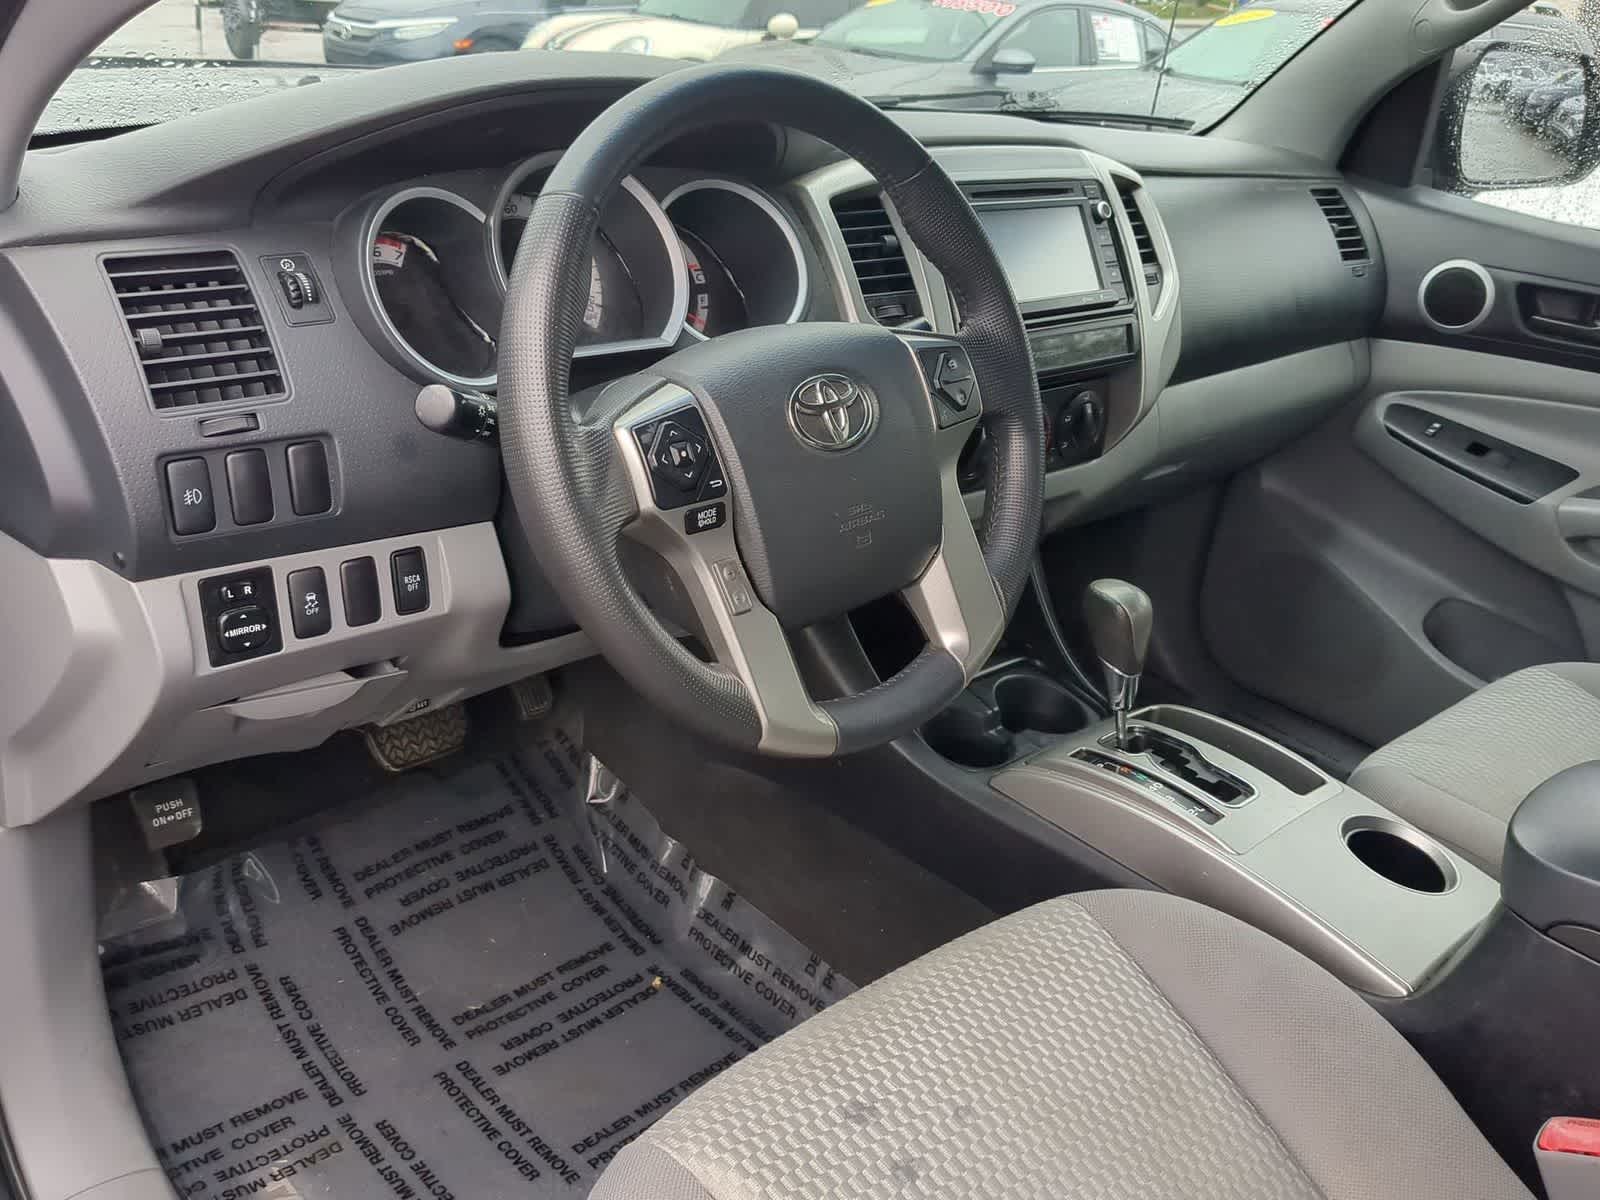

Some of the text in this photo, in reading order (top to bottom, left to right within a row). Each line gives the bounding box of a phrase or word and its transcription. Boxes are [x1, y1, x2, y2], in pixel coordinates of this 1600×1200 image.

[394, 249, 404, 261] 7
[697, 507, 717, 521] MODE
[227, 585, 253, 599] L R
[404, 574, 421, 584] RSCA
[407, 582, 419, 592] OFF
[229, 624, 262, 638] MIRROR
[305, 606, 320, 616] OFF
[154, 798, 183, 813] PUSH
[353, 848, 413, 883] DEALER
[364, 850, 456, 899] PROTECTIVE
[400, 839, 539, 906] PROTECTIVE COVER
[572, 844, 607, 886] COVER
[636, 871, 671, 908] COVER
[389, 857, 551, 937] DEALER MUST REMOVE
[333, 925, 422, 1048] PROTECTIVE COVER
[354, 915, 457, 1051] DEALER MUST REMOVE
[451, 940, 616, 1027] DEALER MUST REMOVE
[687, 925, 755, 986] PROTECTIVE
[754, 980, 799, 1020] COVER
[696, 907, 741, 947] DEALER
[738, 939, 773, 972] MUST
[771, 967, 826, 1013] REMOVE
[127, 968, 239, 1015] PROTECTIVE
[177, 988, 249, 1031] DEALER
[464, 963, 613, 1040] PROTECTIVE COVER
[500, 972, 645, 1051] PROTECTIVE COVER
[244, 961, 345, 1108] DEALER MUST REMOVE
[278, 974, 369, 1098] PROTECTIVE COVER
[491, 986, 659, 1077] DEALER MUST REMOVE
[724, 1027, 760, 1053] ALER
[170, 1087, 310, 1156] MUST REMOVE
[433, 1070, 542, 1183] PROTECTIVE COVER
[455, 1059, 582, 1186] DEALER MUST REMOVE
[571, 1113, 637, 1155] DEALER
[634, 1085, 681, 1119] MUST
[678, 1050, 741, 1093] REMOVE
[212, 1123, 332, 1183] PROTECTIVE
[230, 1115, 297, 1151] COVER
[269, 1140, 345, 1184] DEALER
[335, 1112, 417, 1200] MUST REMOVE
[374, 1118, 456, 1200] ECTIVE COVER
[214, 1177, 268, 1200] MUS
